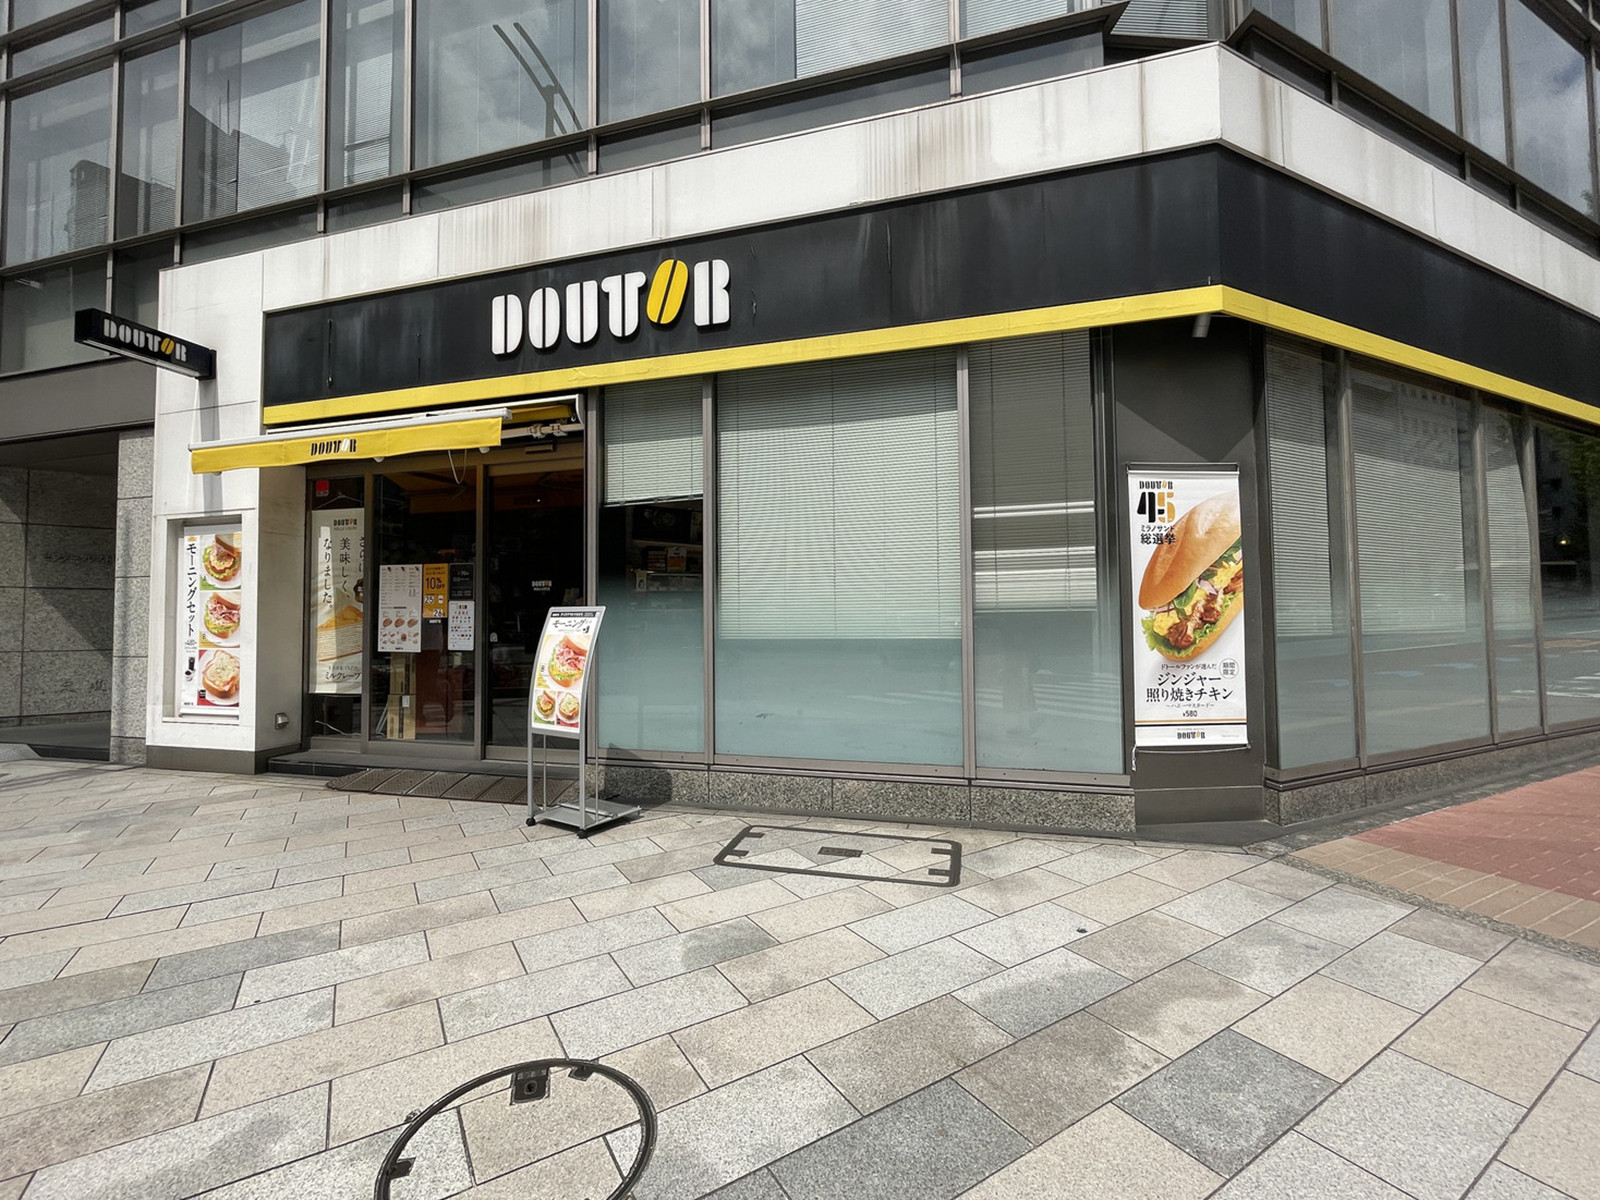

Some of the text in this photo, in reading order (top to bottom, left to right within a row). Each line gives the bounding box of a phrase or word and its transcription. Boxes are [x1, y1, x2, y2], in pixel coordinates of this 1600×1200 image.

[491, 258, 731, 356] DOUTOR
[103, 318, 188, 363] DOUTOR
[310, 438, 357, 456] DOUTOR
[1139, 480, 1174, 490] DOUTOR
[1136, 491, 1176, 523] 45
[1140, 524, 1175, 532] ミラノサンド
[1140, 532, 1176, 545] 総選挙
[323, 538, 334, 609] なりました。
[339, 537, 351, 599] 美味しく、
[186, 543, 198, 637] モーニングセット
[553, 619, 587, 628] モーニング
[1157, 671, 1222, 687] ジンジャー
[1146, 687, 1234, 703] 照り焼きチキン
[1177, 731, 1206, 740] DOUTOR
